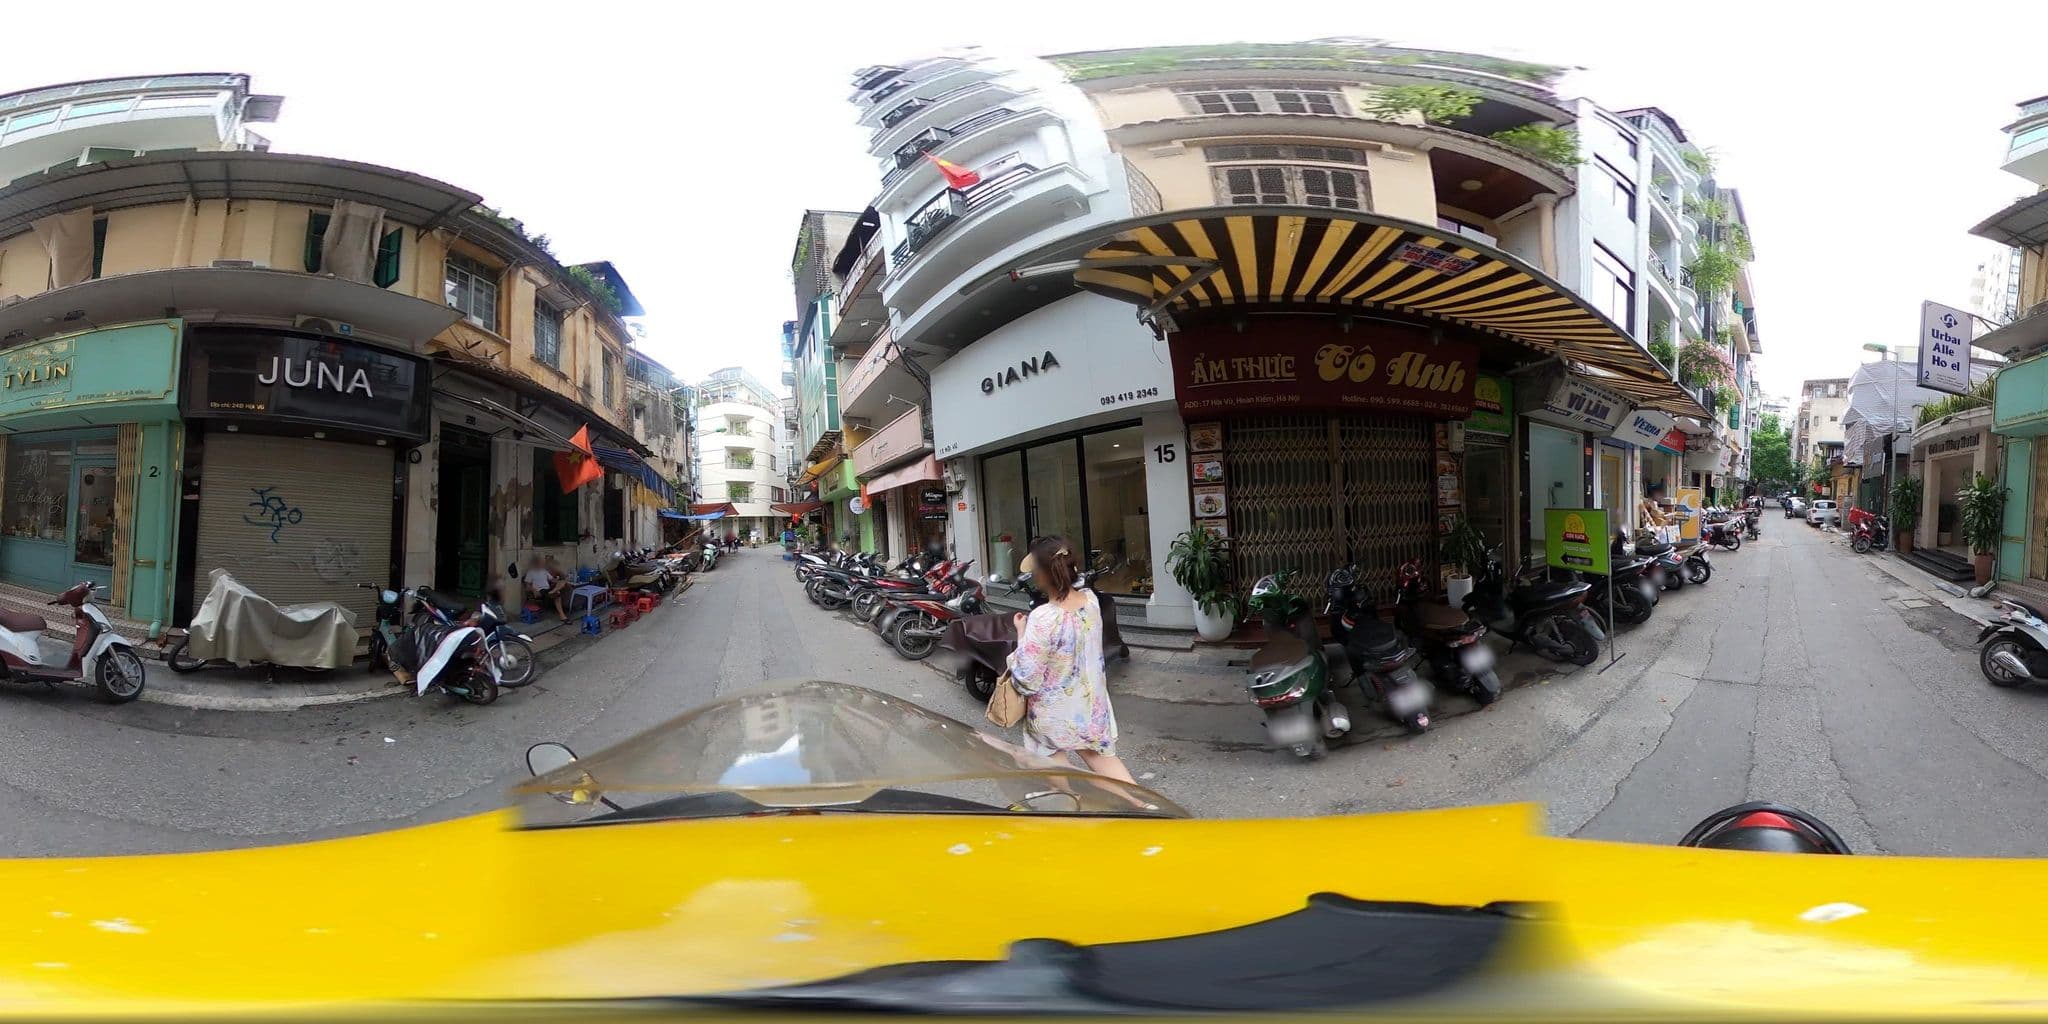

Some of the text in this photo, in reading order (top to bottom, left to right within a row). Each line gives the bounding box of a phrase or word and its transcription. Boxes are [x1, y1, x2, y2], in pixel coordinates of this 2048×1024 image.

[3, 361, 69, 390] TYLIN
[257, 356, 374, 399] JUNA
[981, 350, 1060, 394] GIANA
[1314, 343, 1467, 393] Tô Anh
[1101, 387, 1159, 406] 093 419 2345
[1153, 443, 1176, 465] 15
